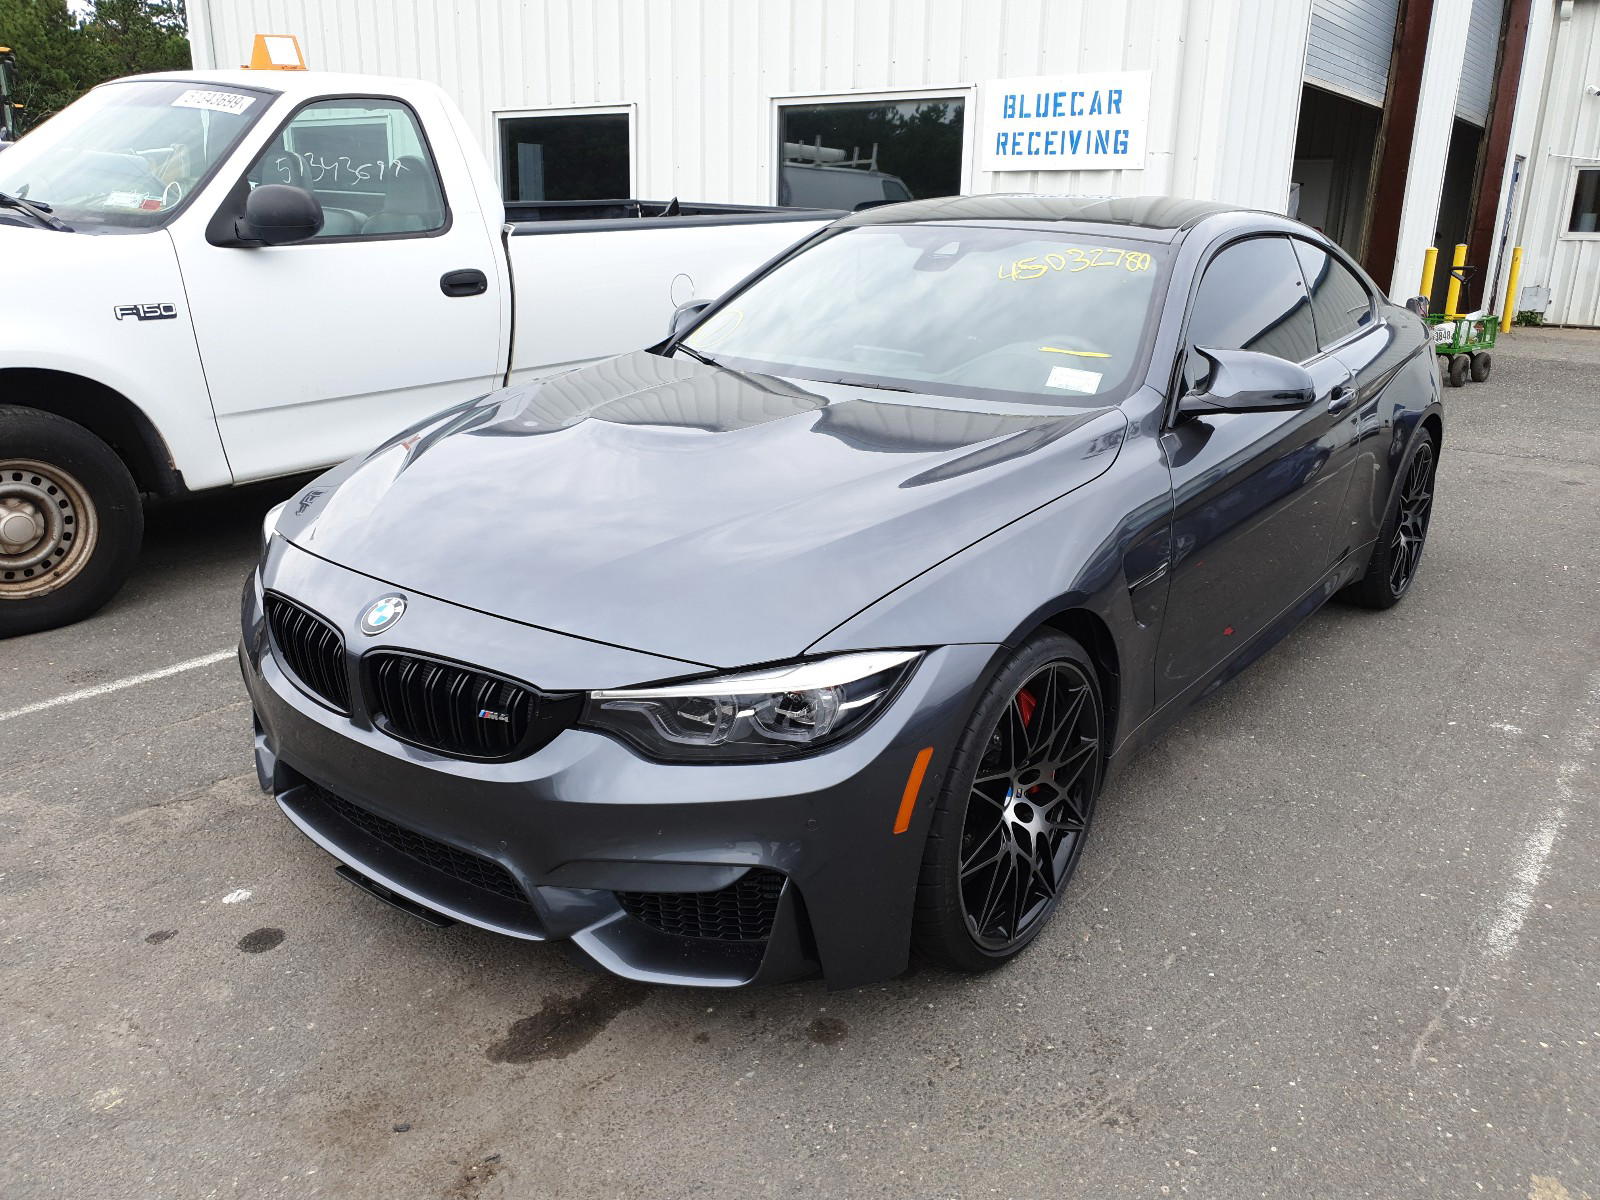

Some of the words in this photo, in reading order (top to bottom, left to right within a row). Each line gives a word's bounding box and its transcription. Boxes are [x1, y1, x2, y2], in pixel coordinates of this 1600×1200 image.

[1003, 89, 1123, 119] BLUECAR
[996, 129, 1129, 156] RECEIVING
[998, 248, 1151, 281] 45032780
